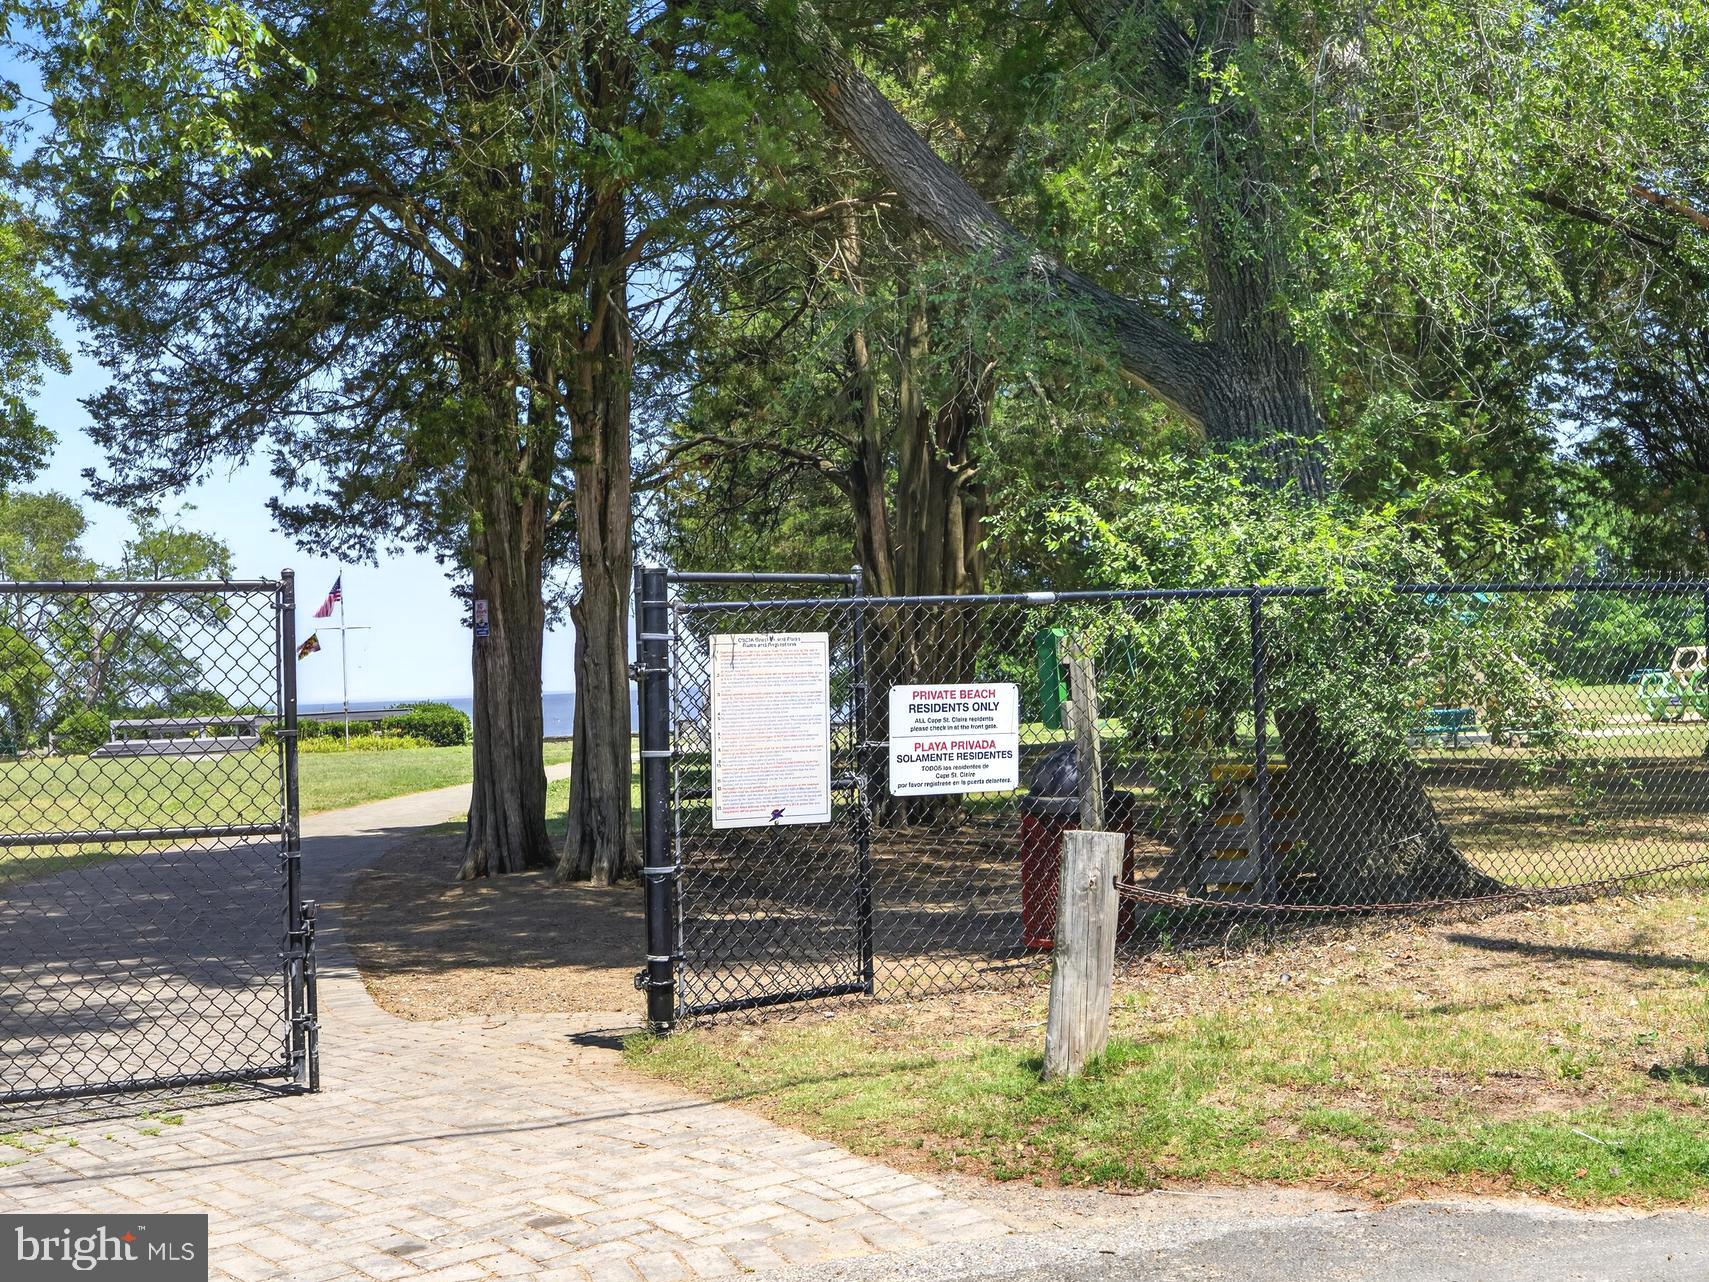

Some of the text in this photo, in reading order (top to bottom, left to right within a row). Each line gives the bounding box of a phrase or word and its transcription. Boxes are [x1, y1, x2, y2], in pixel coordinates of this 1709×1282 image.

[913, 689, 996, 700] PRIVATE BEACH
[909, 702, 1000, 713] RESIDENTS ONLY
[914, 740, 996, 752] PLAYA PRIVADA
[897, 750, 1013, 763] SOLAMENTE RESIDENTES
